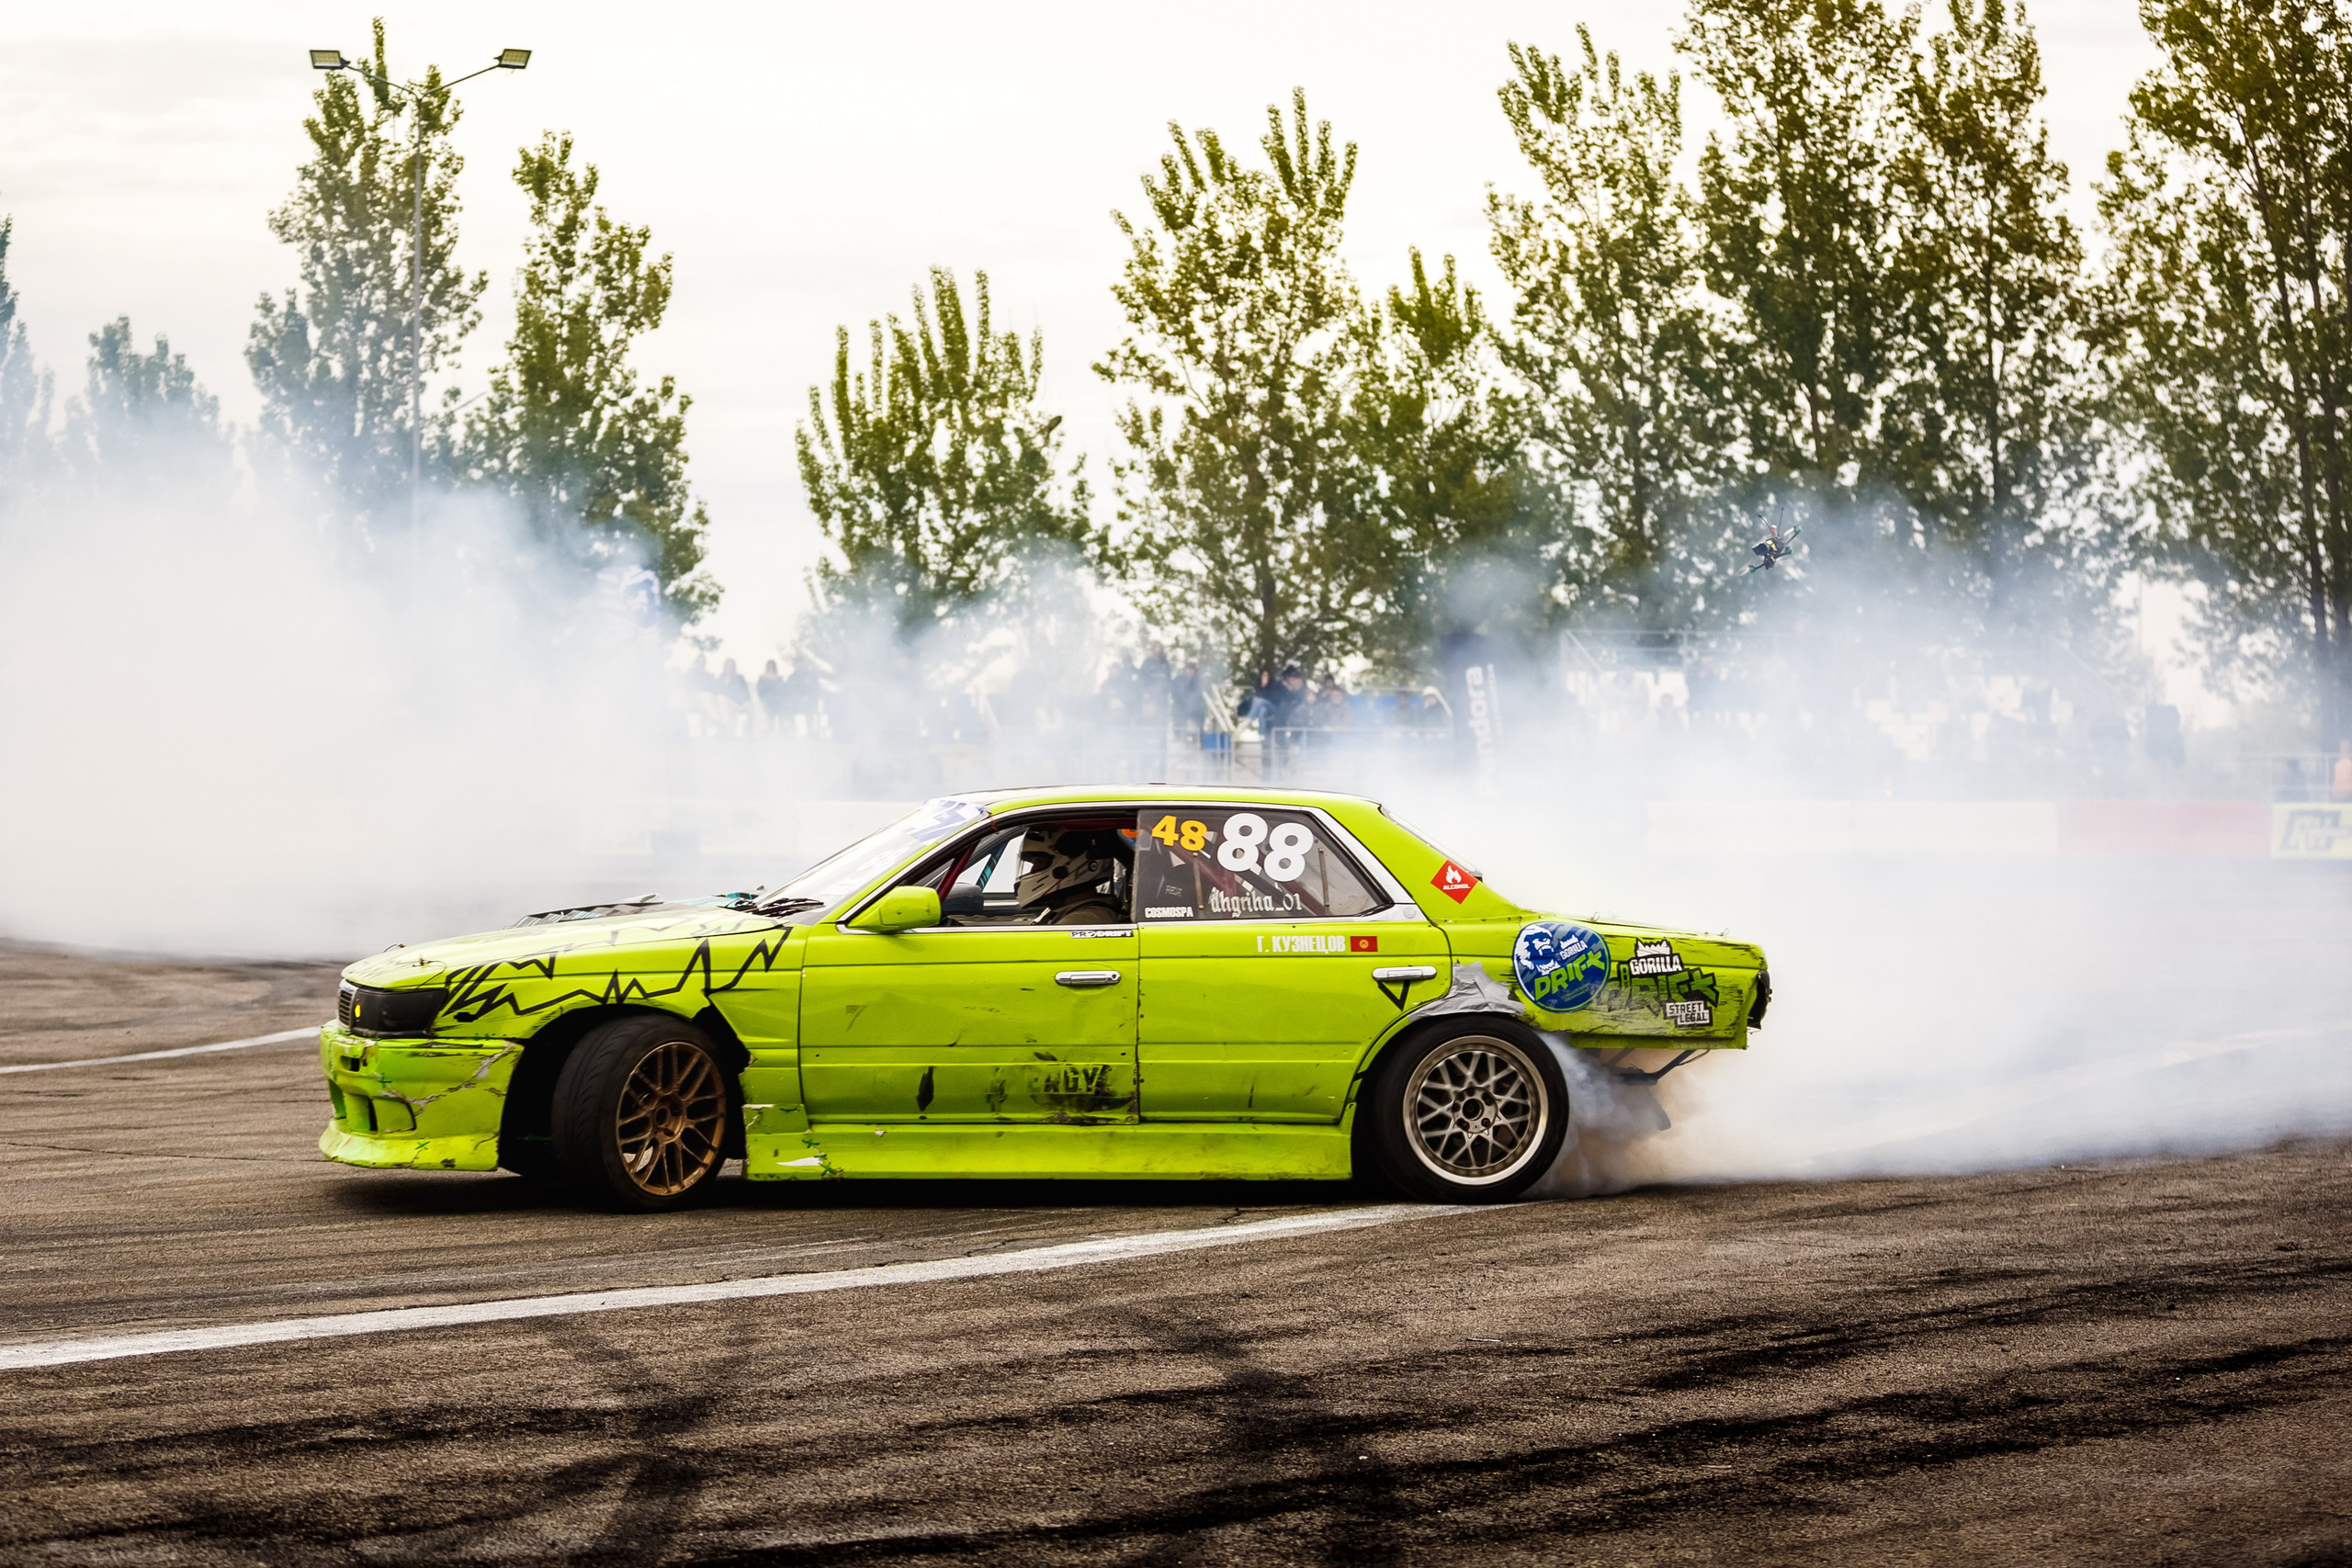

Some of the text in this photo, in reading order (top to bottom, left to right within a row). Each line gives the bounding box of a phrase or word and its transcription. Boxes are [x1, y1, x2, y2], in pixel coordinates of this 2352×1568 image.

[1152, 815, 1207, 851] 48
[1217, 813, 1314, 882] 88
[1442, 883, 1471, 891] ALCOHOL
[1145, 906, 1194, 918] COSMOSPA
[1257, 935, 1346, 953] Г. КУЗНЕЦОВ
[1559, 940, 1589, 960] GORILLA
[1629, 955, 1683, 976] GORILLA
[1668, 1002, 1703, 1015] STREET
[1679, 1012, 1709, 1023] LEGAL
